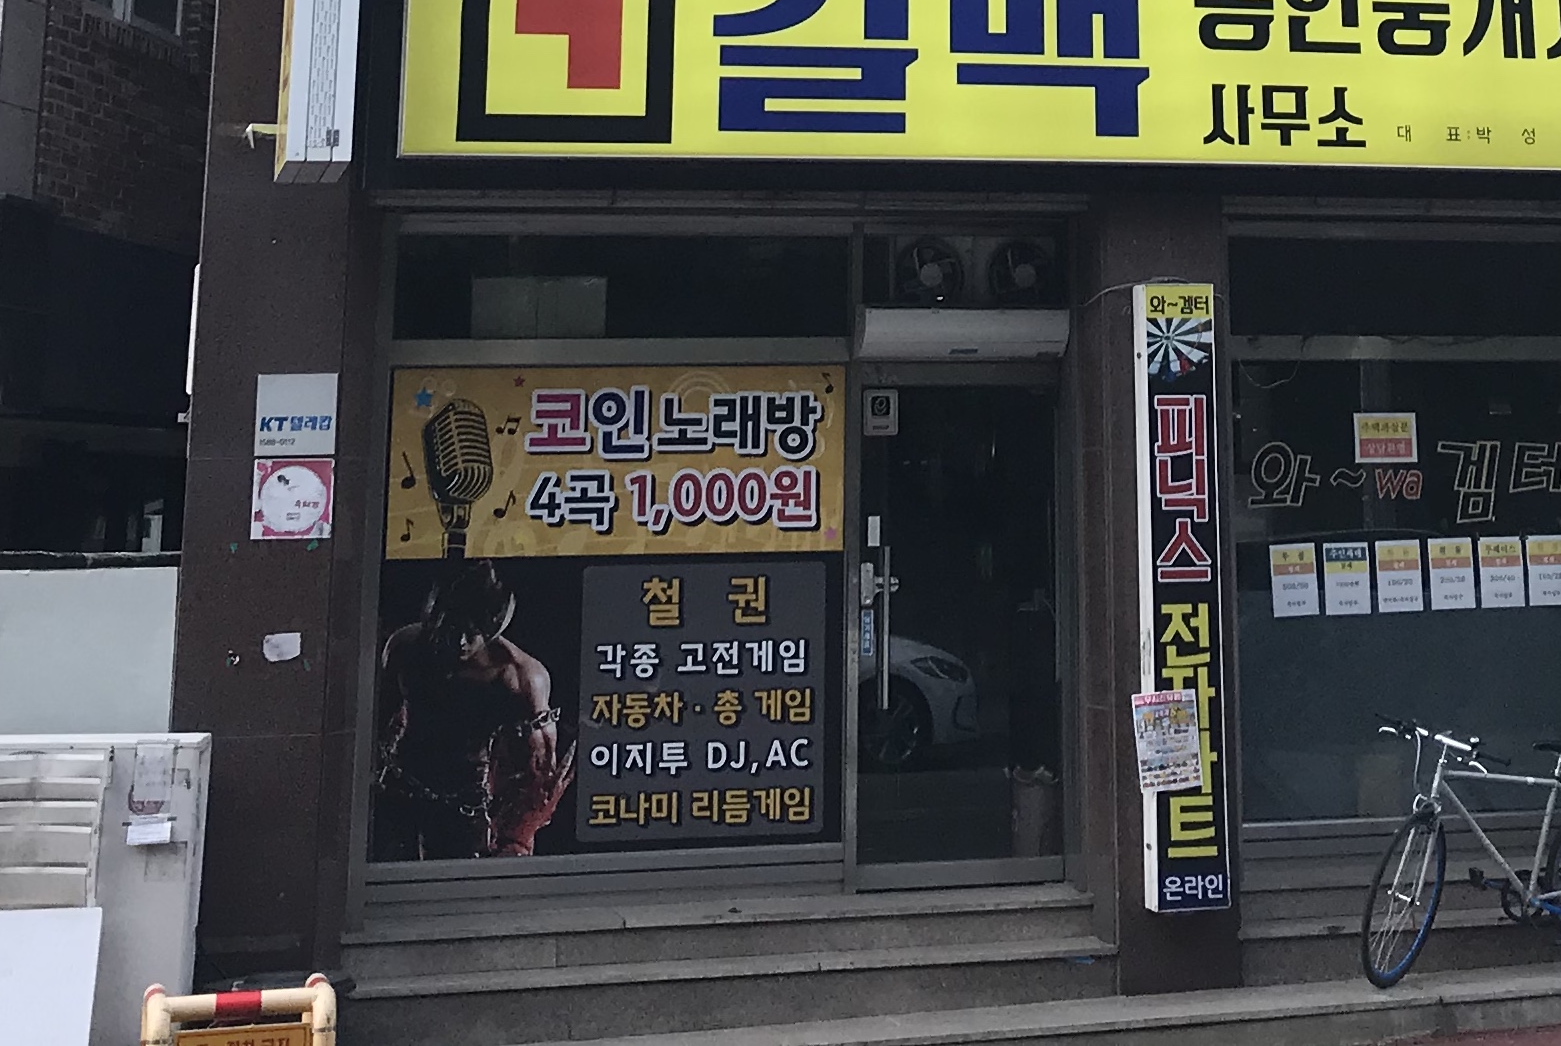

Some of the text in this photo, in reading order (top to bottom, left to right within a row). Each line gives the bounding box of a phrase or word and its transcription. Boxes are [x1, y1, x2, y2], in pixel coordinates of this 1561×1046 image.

[1203, 84, 1366, 148] 사무소
[526, 465, 817, 531] 4곡 1,000원
[1154, 394, 1211, 582] 피닉스
[596, 639, 807, 677] 각종 고전게임
[754, 688, 811, 723] 게임
[591, 743, 688, 775] 이지투
[589, 787, 812, 826] 코나미 리듬게임
[1163, 874, 1224, 901] 온라인
